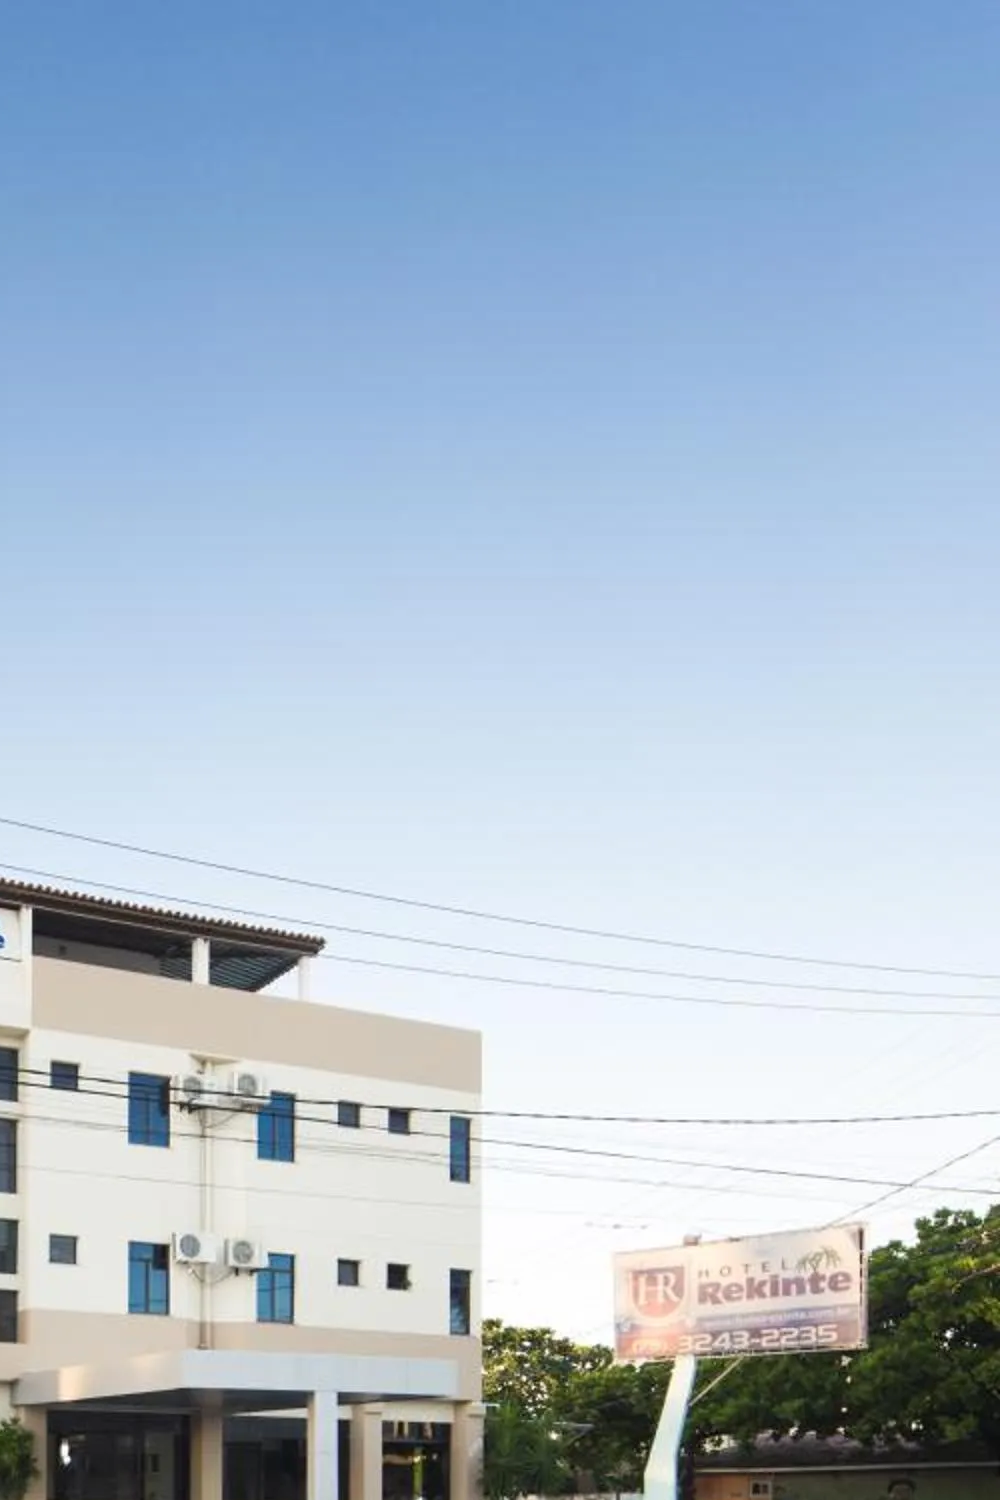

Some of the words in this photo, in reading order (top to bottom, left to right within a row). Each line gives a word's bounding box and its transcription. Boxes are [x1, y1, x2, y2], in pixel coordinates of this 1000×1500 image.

[698, 1257, 792, 1278] HOTEL
[698, 1270, 853, 1305] Rekinte
[678, 1324, 839, 1353] 3243-2235
